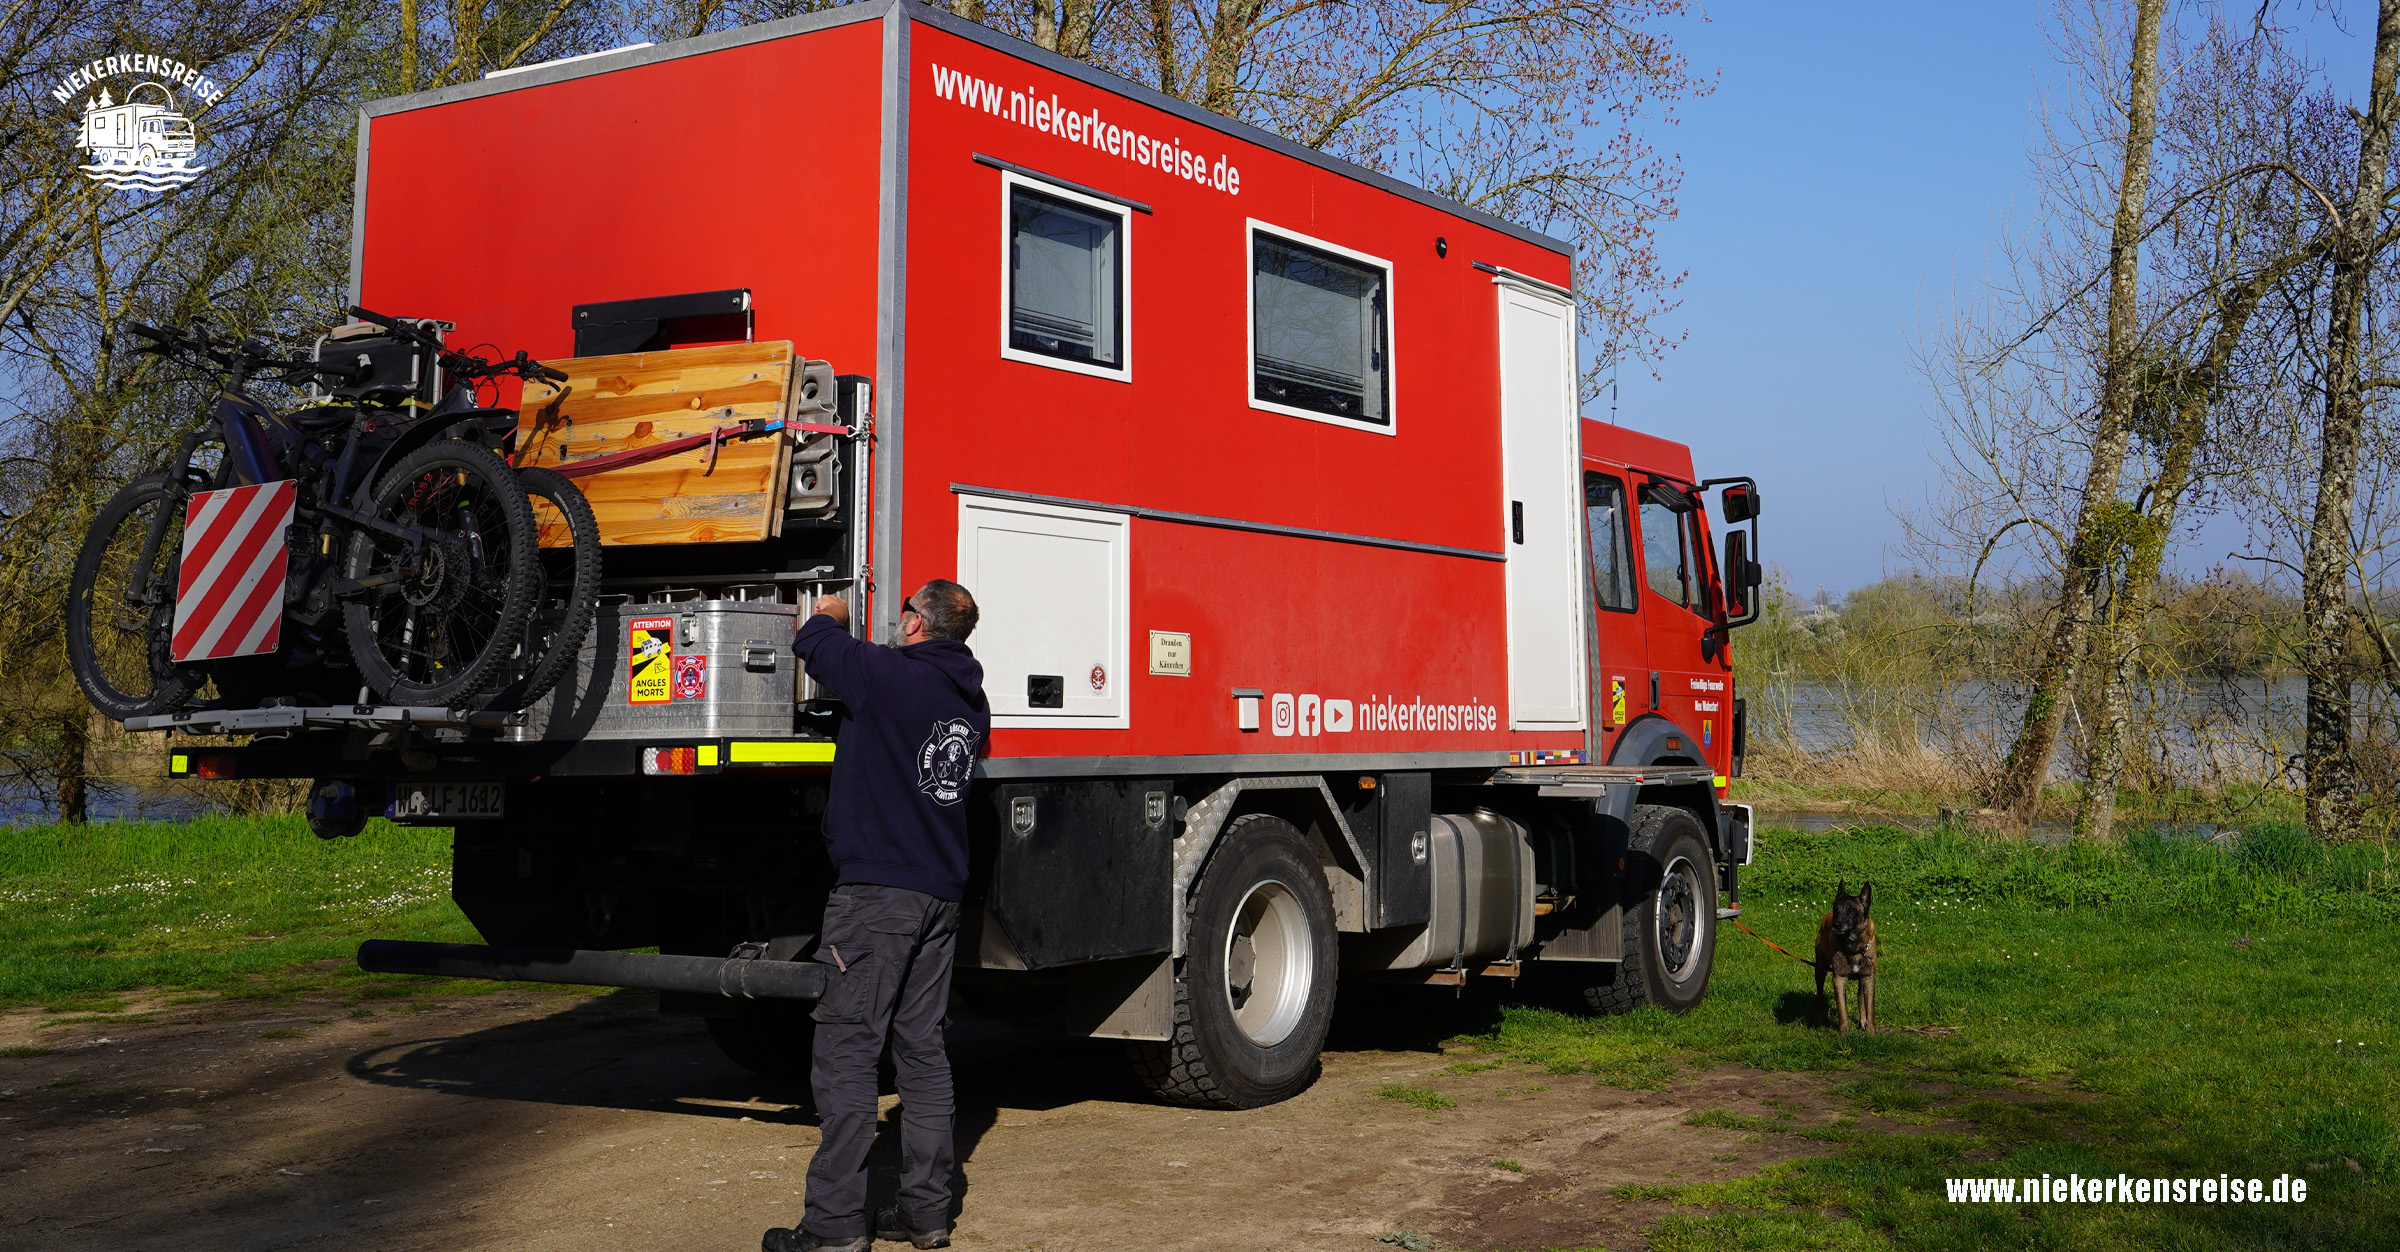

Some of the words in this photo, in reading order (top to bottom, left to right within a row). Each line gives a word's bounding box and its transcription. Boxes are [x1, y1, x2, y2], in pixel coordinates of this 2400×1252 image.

[931, 62, 1240, 196] www.niekerkensreise.de
[632, 620, 671, 629] ATTENTION
[1159, 660, 1184, 669] Kännchen
[636, 679, 666, 688] ANGLES
[637, 688, 664, 697] MORTS
[1359, 694, 1497, 732] niekerkensreise
[923, 743, 936, 769] RETTEN
[397, 786, 418, 813] WL
[431, 786, 453, 813] LF
[457, 786, 501, 813] 1612
